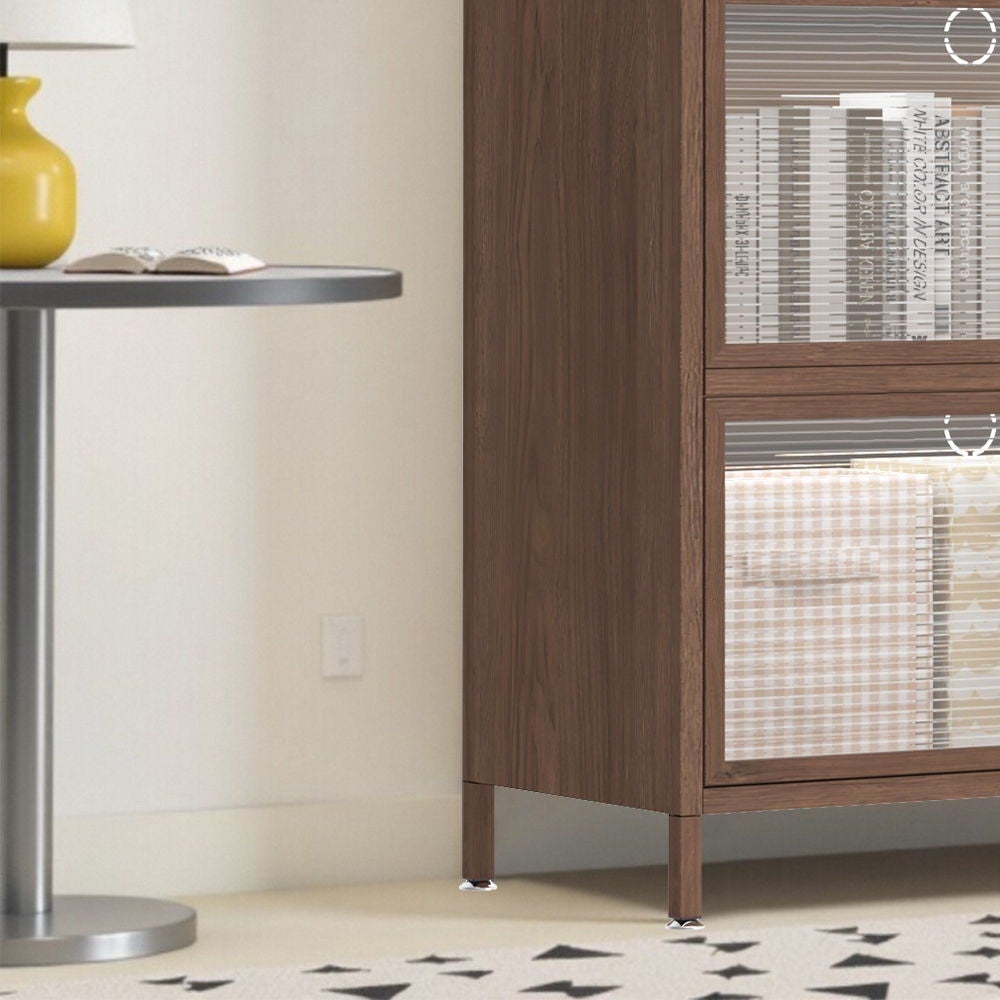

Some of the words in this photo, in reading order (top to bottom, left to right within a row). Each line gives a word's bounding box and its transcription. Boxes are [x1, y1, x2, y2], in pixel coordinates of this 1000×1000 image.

[913, 108, 927, 155] WHITE
[958, 127, 972, 175] wright
[913, 158, 927, 215] COLOR
[934, 115, 950, 214] ABSTRACT
[913, 217, 927, 234] IN
[935, 219, 950, 256] ART
[960, 182, 973, 278] architecture
[913, 239, 927, 301] DESIGN
